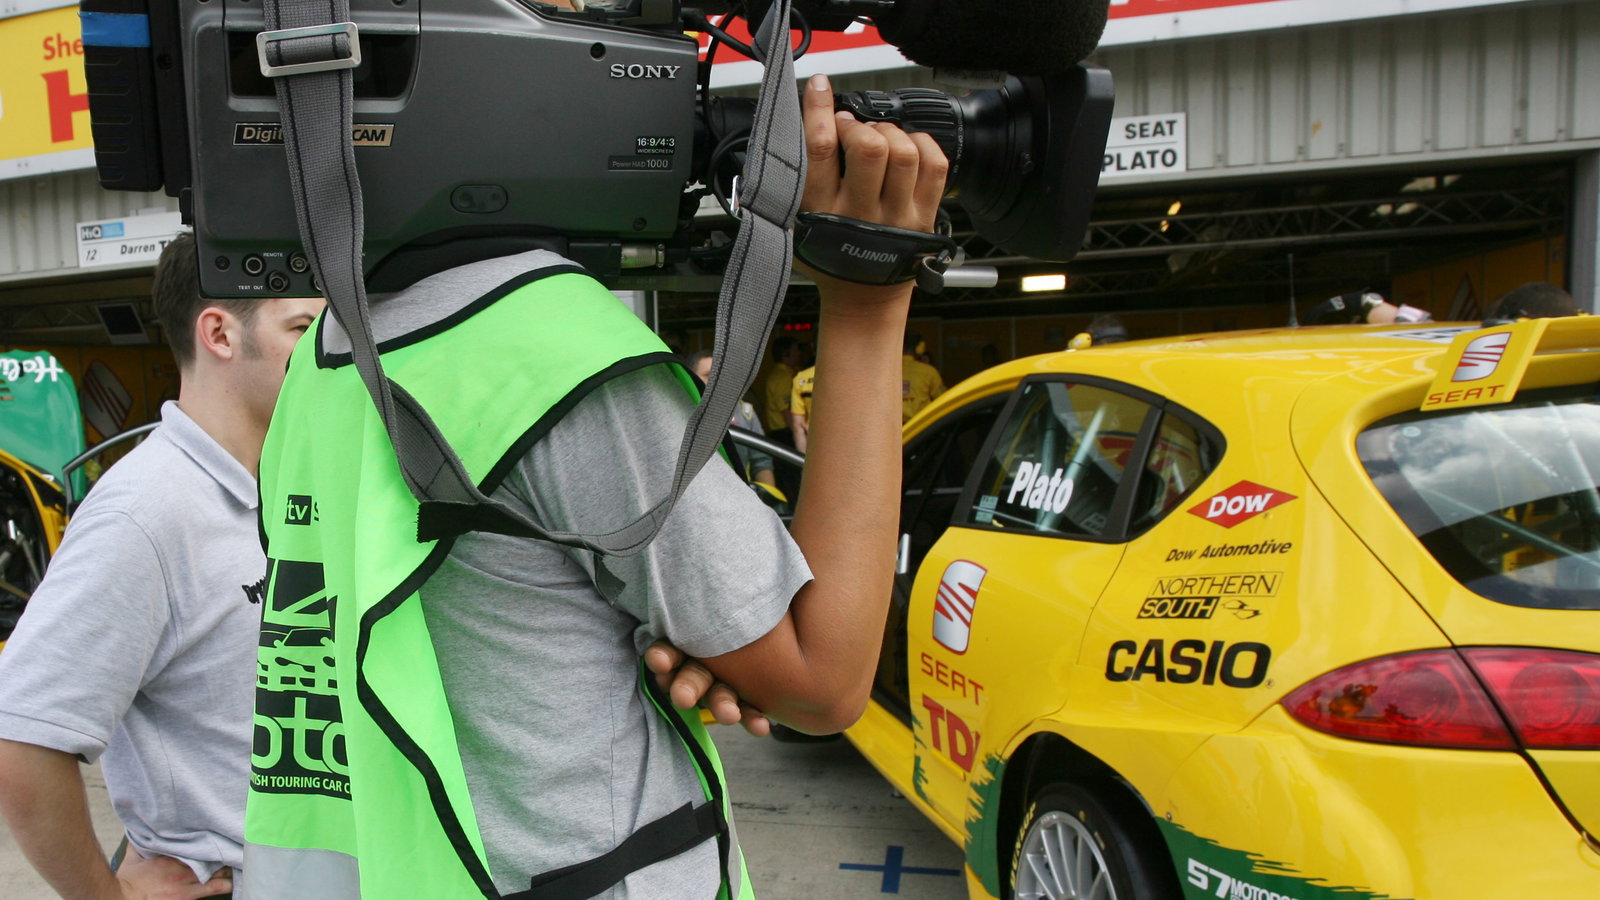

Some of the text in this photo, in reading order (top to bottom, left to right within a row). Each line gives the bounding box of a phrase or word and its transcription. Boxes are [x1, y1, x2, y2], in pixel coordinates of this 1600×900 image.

[610, 63, 681, 79] SONY
[1125, 120, 1177, 139] SEAT
[637, 137, 675, 147] 16:9/4:3
[647, 159, 669, 168] 1000
[1101, 148, 1177, 172] PLATO
[120, 243, 156, 255] Darren
[840, 243, 899, 263] FUJINON
[0, 355, 64, 383] Holi
[1425, 384, 1505, 406] SEAT
[1006, 461, 1074, 514] Plato
[1206, 492, 1274, 519] DOW
[1164, 539, 1293, 562] Dow Automotive
[1152, 575, 1278, 596] NORTHERN
[1140, 598, 1217, 619] SOUTH
[1104, 638, 1272, 689] CASIO
[920, 652, 985, 706] SEAT
[270, 776, 320, 789] TOURING
[322, 778, 342, 792] CAR
[1230, 877, 1300, 900] MOTOR
